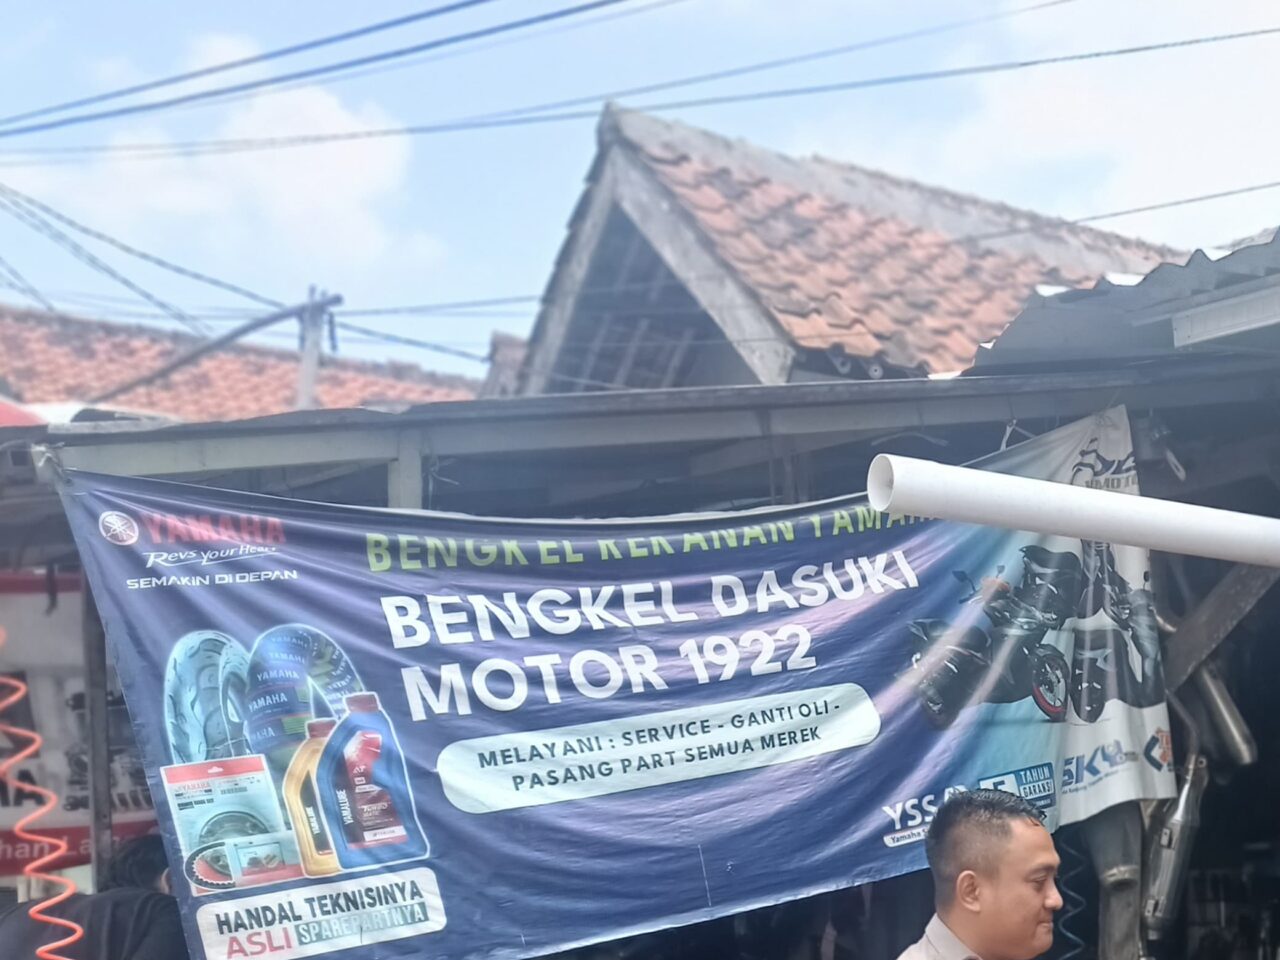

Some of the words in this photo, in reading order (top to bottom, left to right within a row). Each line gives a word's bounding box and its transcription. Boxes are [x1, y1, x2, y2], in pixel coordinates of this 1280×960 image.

[138, 511, 287, 543] YAMAHA
[142, 550, 198, 568] Revs
[199, 548, 239, 566] your
[366, 532, 584, 572] BENGKEL
[126, 574, 210, 589] SEMAKIN
[215, 573, 233, 584] DI
[235, 569, 298, 583] DEPAN
[379, 579, 699, 649] BENGKEL
[711, 550, 920, 618] DASUKI
[399, 643, 668, 722] MOTOR
[679, 623, 818, 684] 1922
[248, 692, 288, 712] YAMAHA
[478, 735, 604, 768] MELAYANI
[621, 719, 711, 747] SERVICE
[730, 706, 794, 729] GANTI
[799, 699, 829, 718] OLI
[511, 760, 613, 791] PASANG
[621, 750, 676, 774] PART
[684, 738, 755, 763] SEMUA
[760, 726, 822, 750] MEREK
[1020, 766, 1051, 783] TAHUN
[215, 901, 302, 935] HANDAL
[304, 880, 424, 919] TEKNISINYA
[226, 927, 293, 960] ASLI
[298, 906, 425, 944] SPAREPARTNYA
